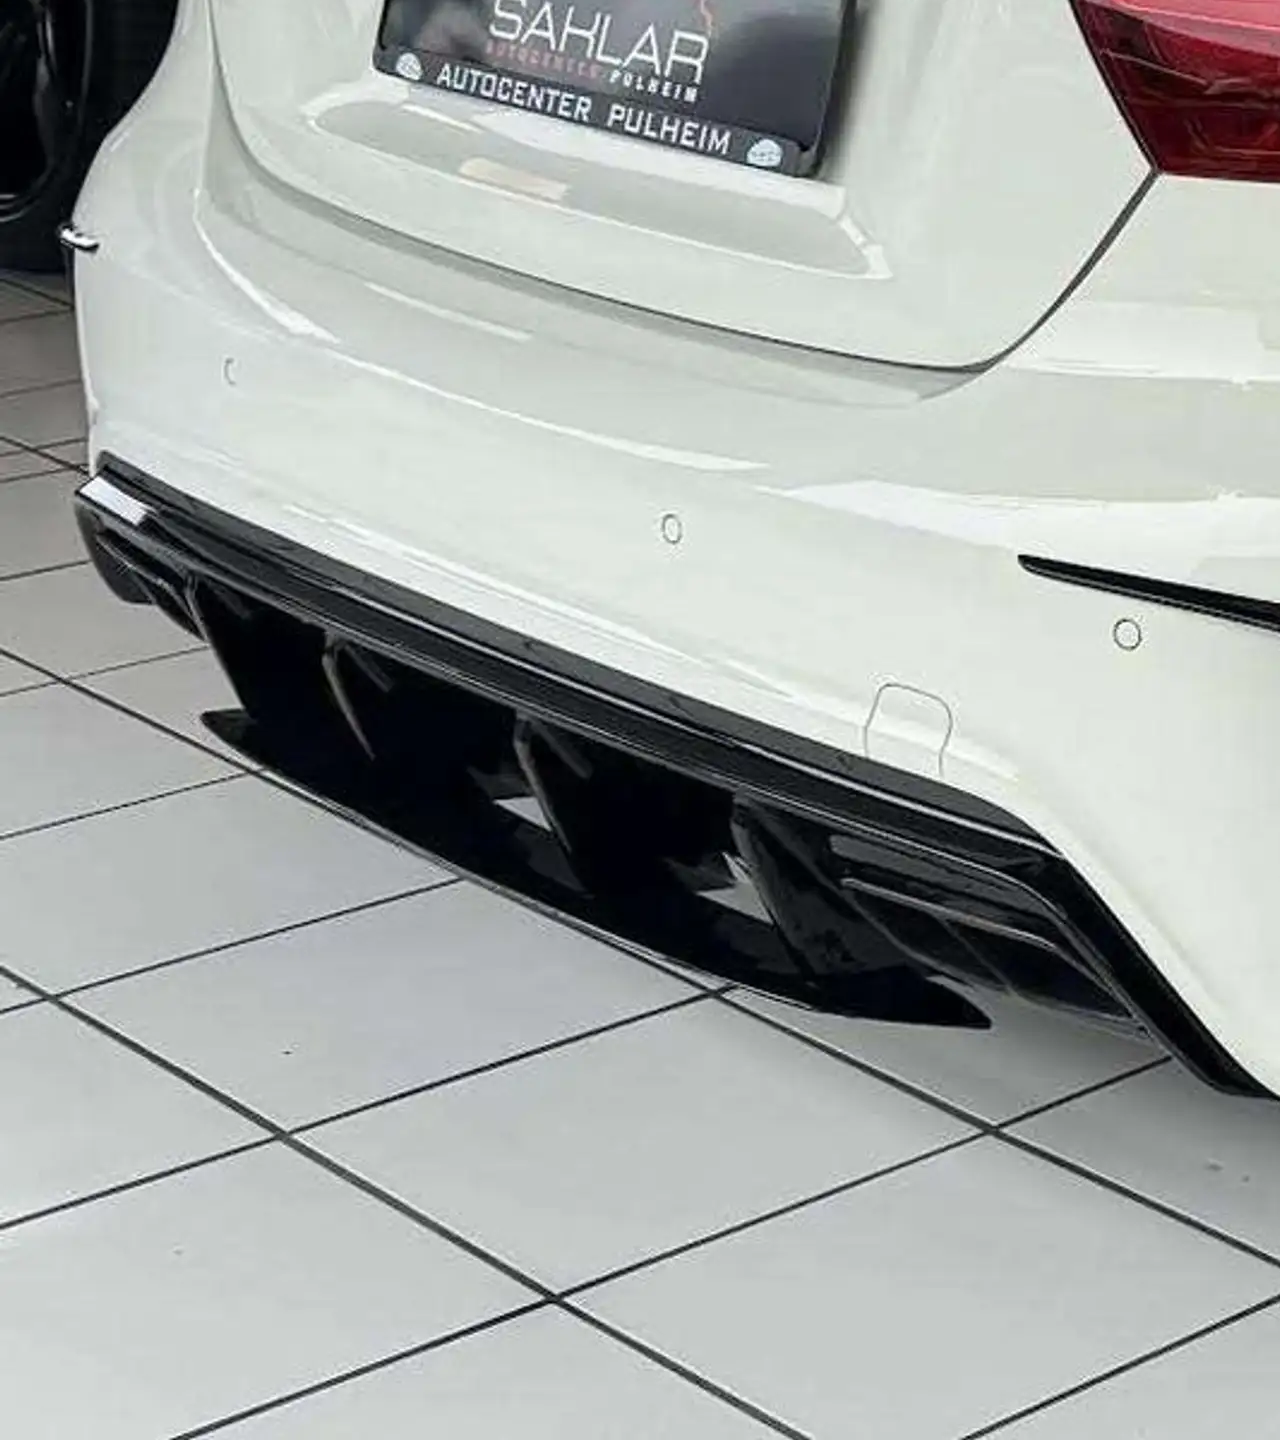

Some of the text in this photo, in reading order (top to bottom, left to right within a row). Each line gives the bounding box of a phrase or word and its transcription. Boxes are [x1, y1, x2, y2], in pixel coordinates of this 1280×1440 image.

[435, 62, 593, 122] AUTOCENTER
[607, 103, 732, 156] PULHEIM
[609, 68, 699, 104] PULHEIM
